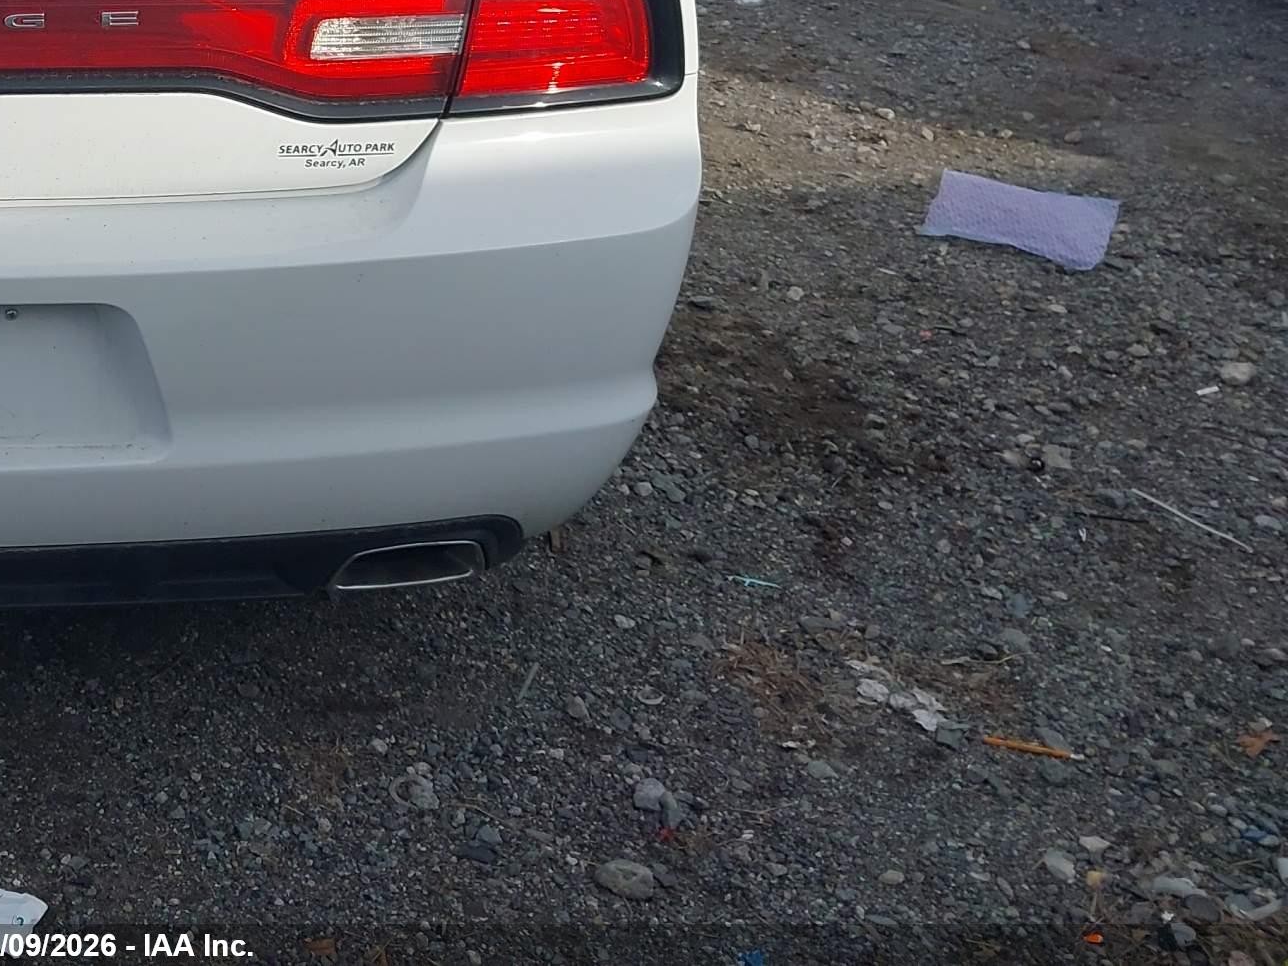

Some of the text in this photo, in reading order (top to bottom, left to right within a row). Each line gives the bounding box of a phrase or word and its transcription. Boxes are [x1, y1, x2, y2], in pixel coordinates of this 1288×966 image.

[278, 139, 395, 156] SEARCY AUTO PARK
[304, 157, 366, 169] Searcy, AR
